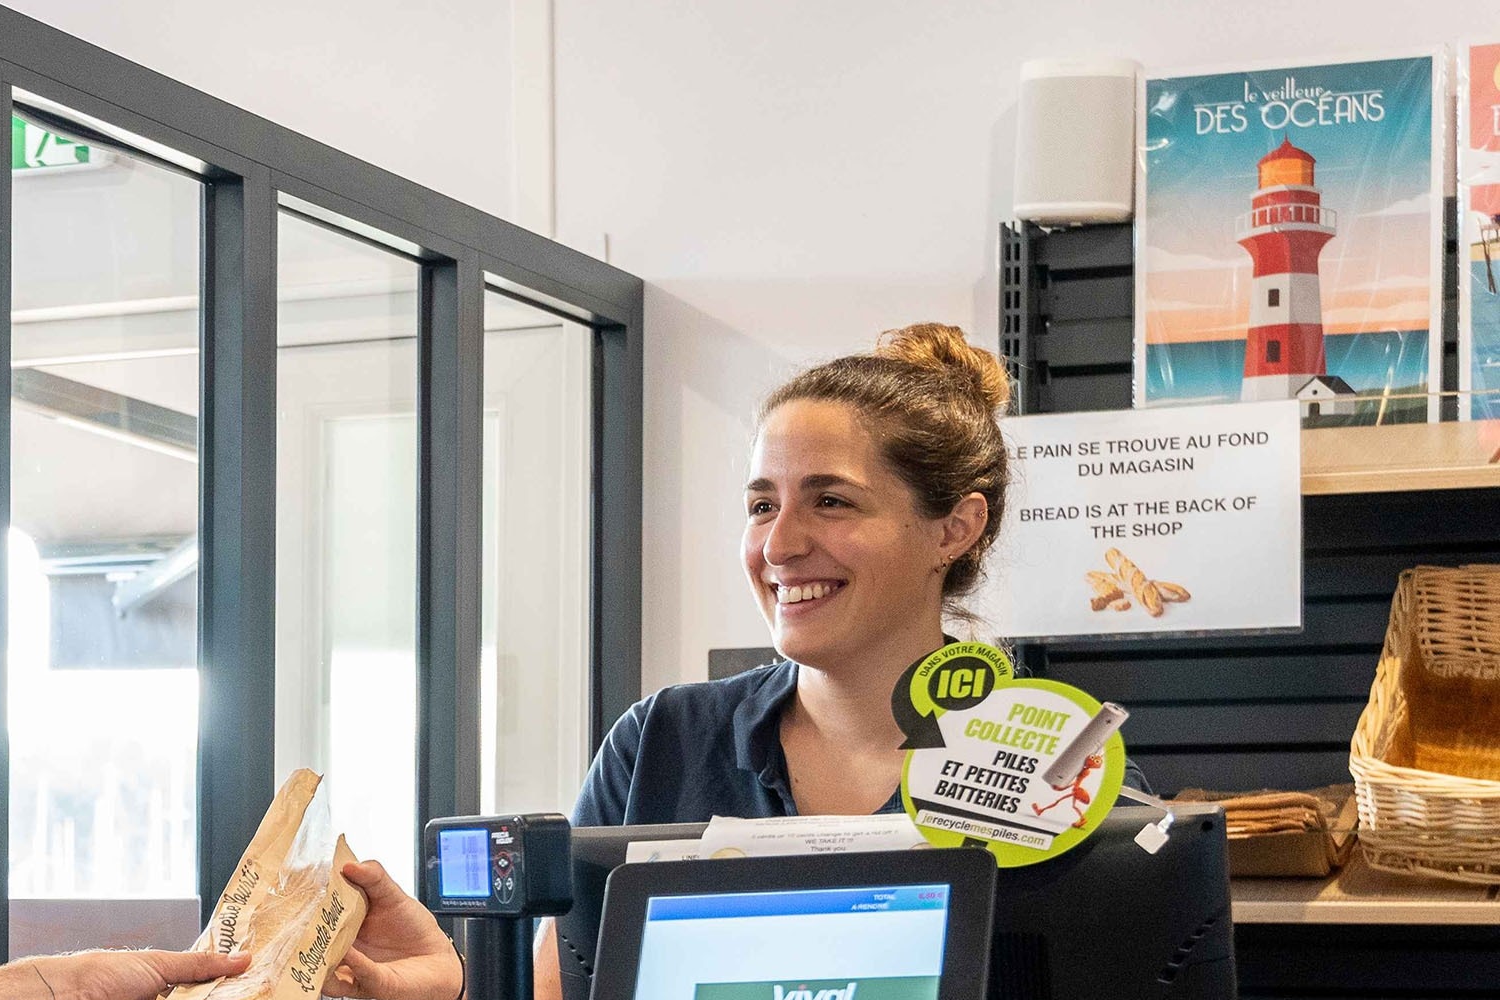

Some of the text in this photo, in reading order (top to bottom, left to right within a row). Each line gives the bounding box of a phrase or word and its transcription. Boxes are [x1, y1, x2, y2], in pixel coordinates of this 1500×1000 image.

[1244, 77, 1325, 103] le veilleur
[1194, 90, 1385, 135] DES OCÉANS
[1033, 443, 1073, 457] PAIN
[1078, 441, 1101, 455] SE
[1106, 437, 1180, 454] TROUVE
[1186, 435, 1211, 449] AU
[1217, 431, 1269, 447] FOND
[1078, 457, 1194, 477] DU MAGASIN
[1019, 496, 1257, 522] BREAD IS AT THE BACK OF
[1091, 522, 1183, 539] THE SHOP
[920, 646, 1008, 677] DANS VOTRE MAGASIN
[937, 669, 986, 698] ICI
[1007, 703, 1071, 732] POINT
[964, 718, 1061, 755] COLLECTE
[941, 760, 1030, 794] ET PETITES
[992, 751, 1039, 774] PILES
[934, 780, 1021, 814] BATTERIES
[922, 814, 1045, 846] jerecyclemespiles.com
[299, 924, 331, 974] Baguette
[291, 967, 315, 992] La
